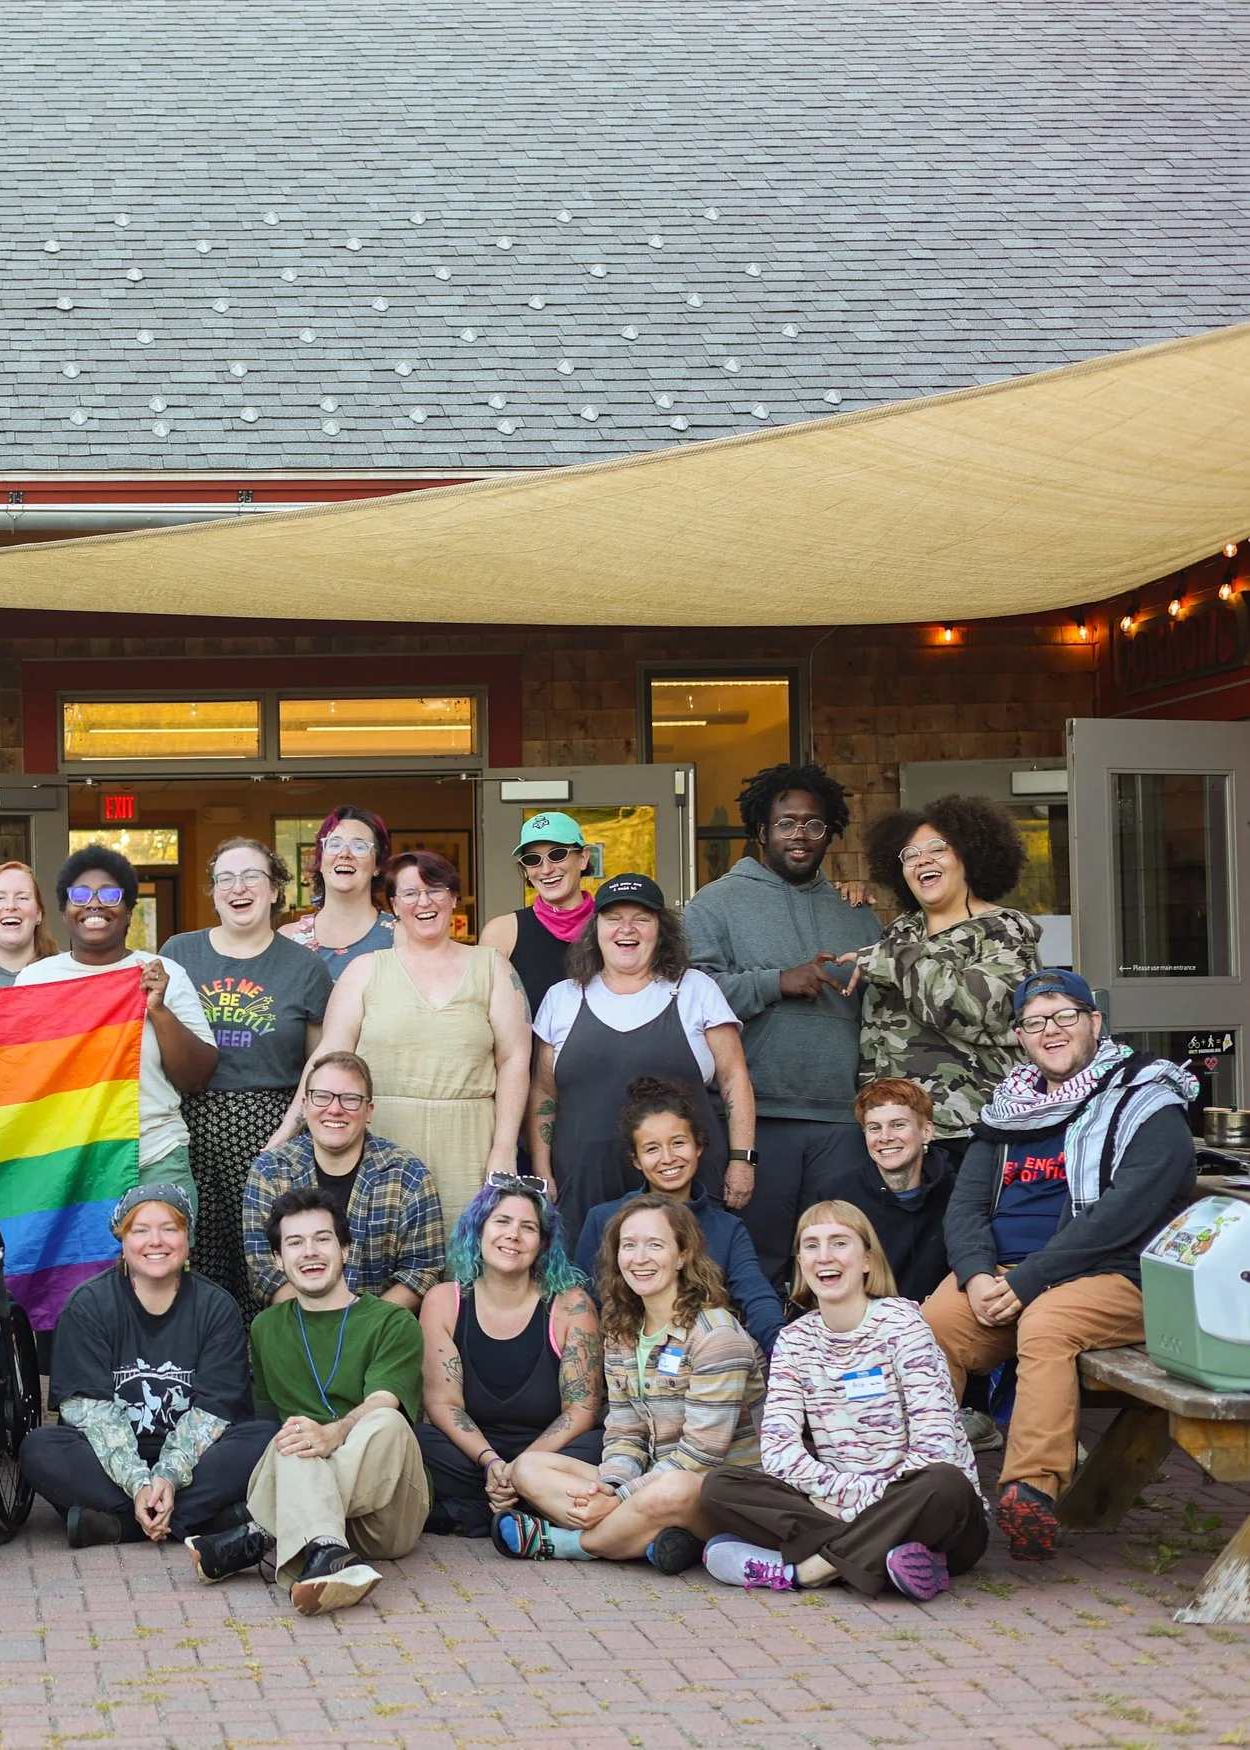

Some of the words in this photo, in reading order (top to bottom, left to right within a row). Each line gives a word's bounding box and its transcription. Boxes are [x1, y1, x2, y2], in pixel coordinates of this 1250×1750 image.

[106, 796, 134, 819] EXIT
[201, 977, 235, 996] LET
[236, 978, 264, 998] ME
[218, 992, 241, 1007] BE
[203, 1006, 276, 1037] RFECTLY
[216, 1029, 252, 1047] EER
